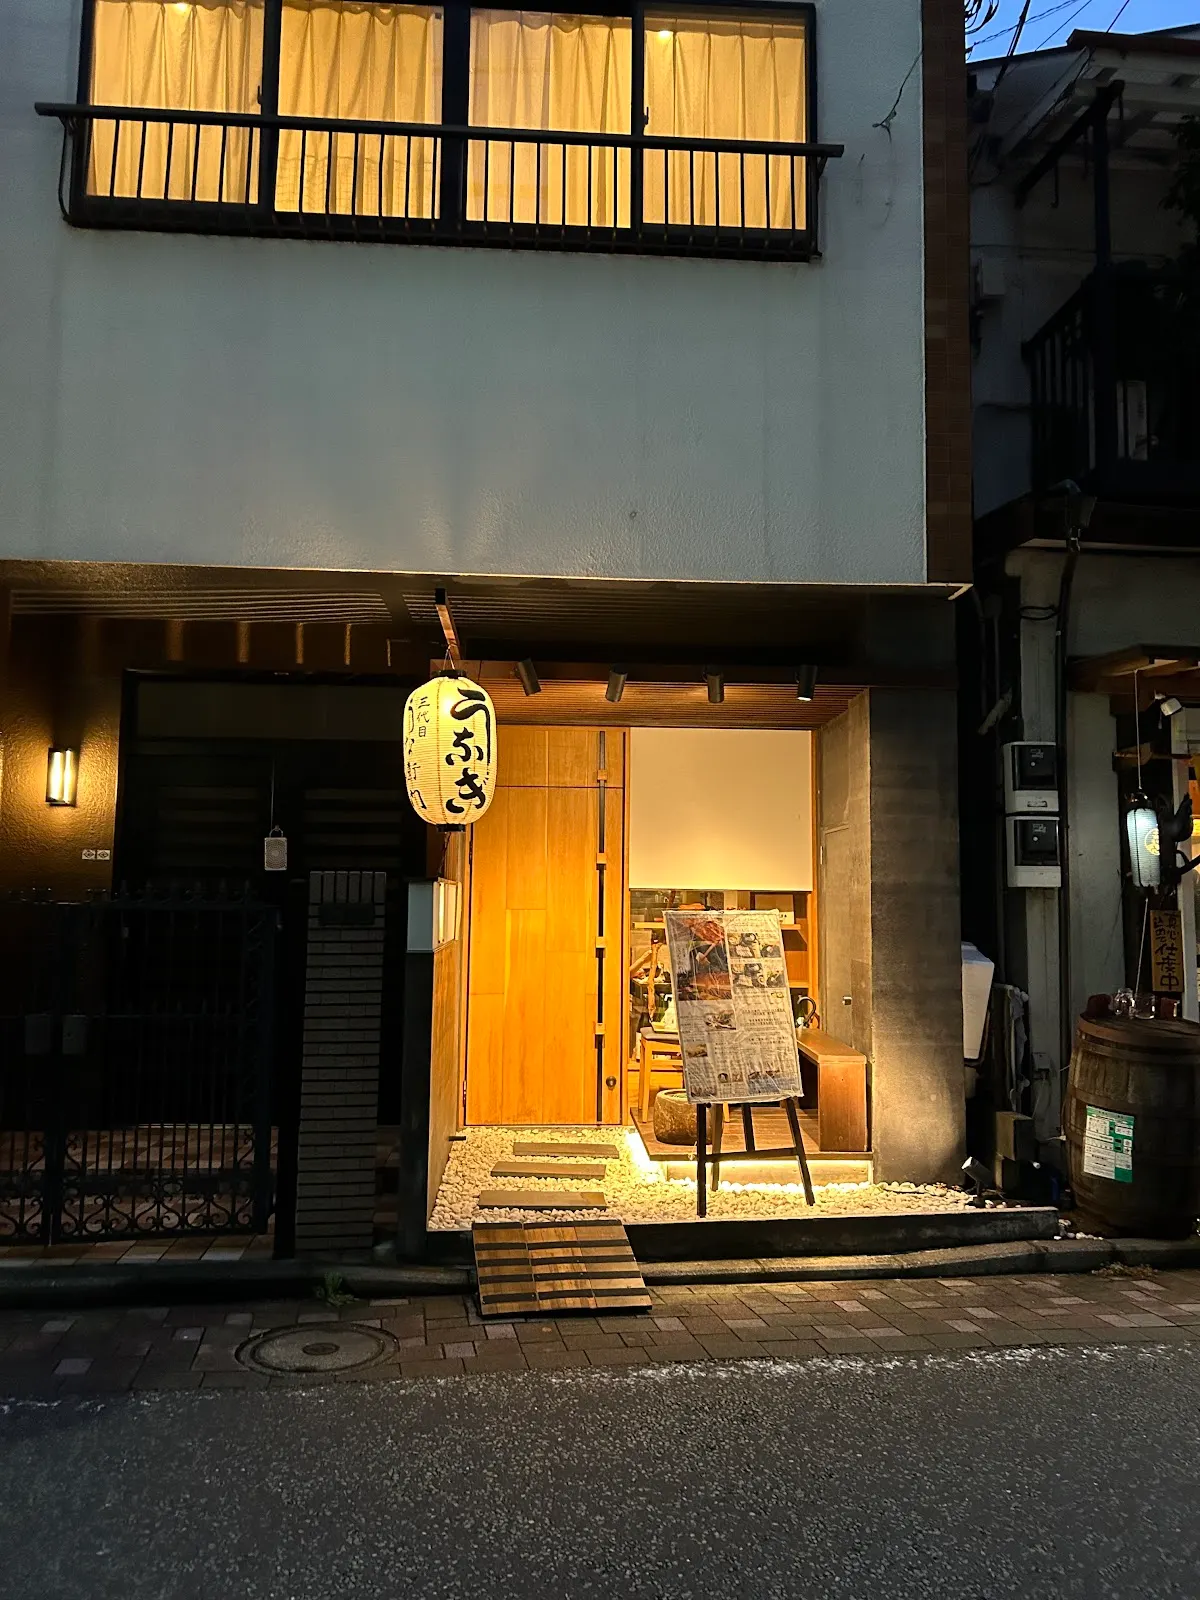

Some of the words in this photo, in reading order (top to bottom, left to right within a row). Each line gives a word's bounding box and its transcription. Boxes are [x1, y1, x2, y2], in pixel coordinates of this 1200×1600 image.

[416, 696, 430, 737] 三代目
[1155, 943, 1180, 990] 仕度中
